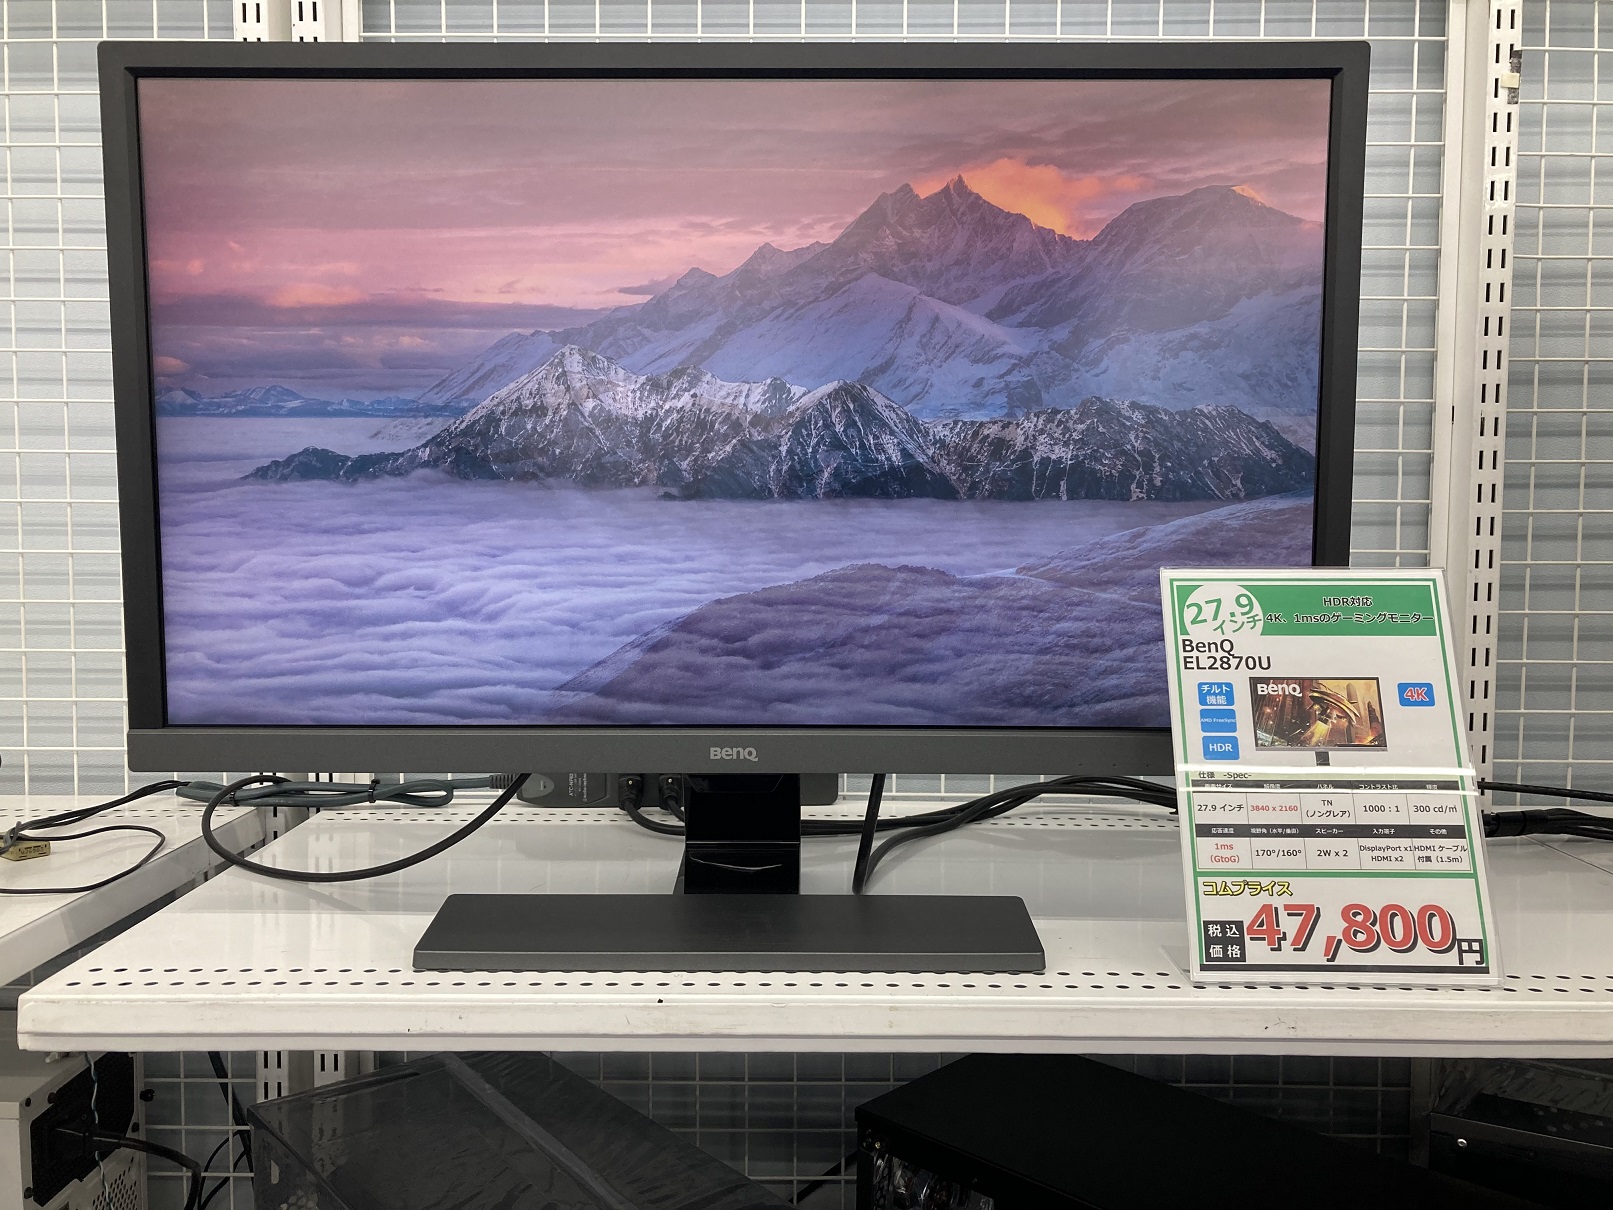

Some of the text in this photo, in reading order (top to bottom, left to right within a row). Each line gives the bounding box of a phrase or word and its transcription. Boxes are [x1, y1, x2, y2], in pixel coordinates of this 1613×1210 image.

[1322, 596, 1374, 608] HDR対応
[1186, 593, 1255, 625] 27.9
[1265, 612, 1435, 624] 4K、1msのゲーミングモニター
[1213, 614, 1262, 635] インチ
[1182, 638, 1235, 657] BenQ
[1183, 655, 1272, 670] EL2870U
[1201, 684, 1231, 693] チルト
[1256, 683, 1303, 697] BenQ
[1404, 687, 1429, 701] 4K
[1206, 695, 1227, 705] 機能
[1209, 743, 1233, 752] HDR
[710, 747, 759, 761] BenQ
[1198, 771, 1215, 779] 仕様
[1197, 804, 1244, 812] 27.9 インチ
[1321, 799, 1333, 807] TN
[1413, 805, 1431, 813] 300
[1317, 849, 1331, 857] 2W
[1342, 849, 1348, 857] 2
[1360, 844, 1402, 853] DisplayPort
[1438, 844, 1468, 852] ケーブル
[1202, 879, 1293, 896] コムプライス
